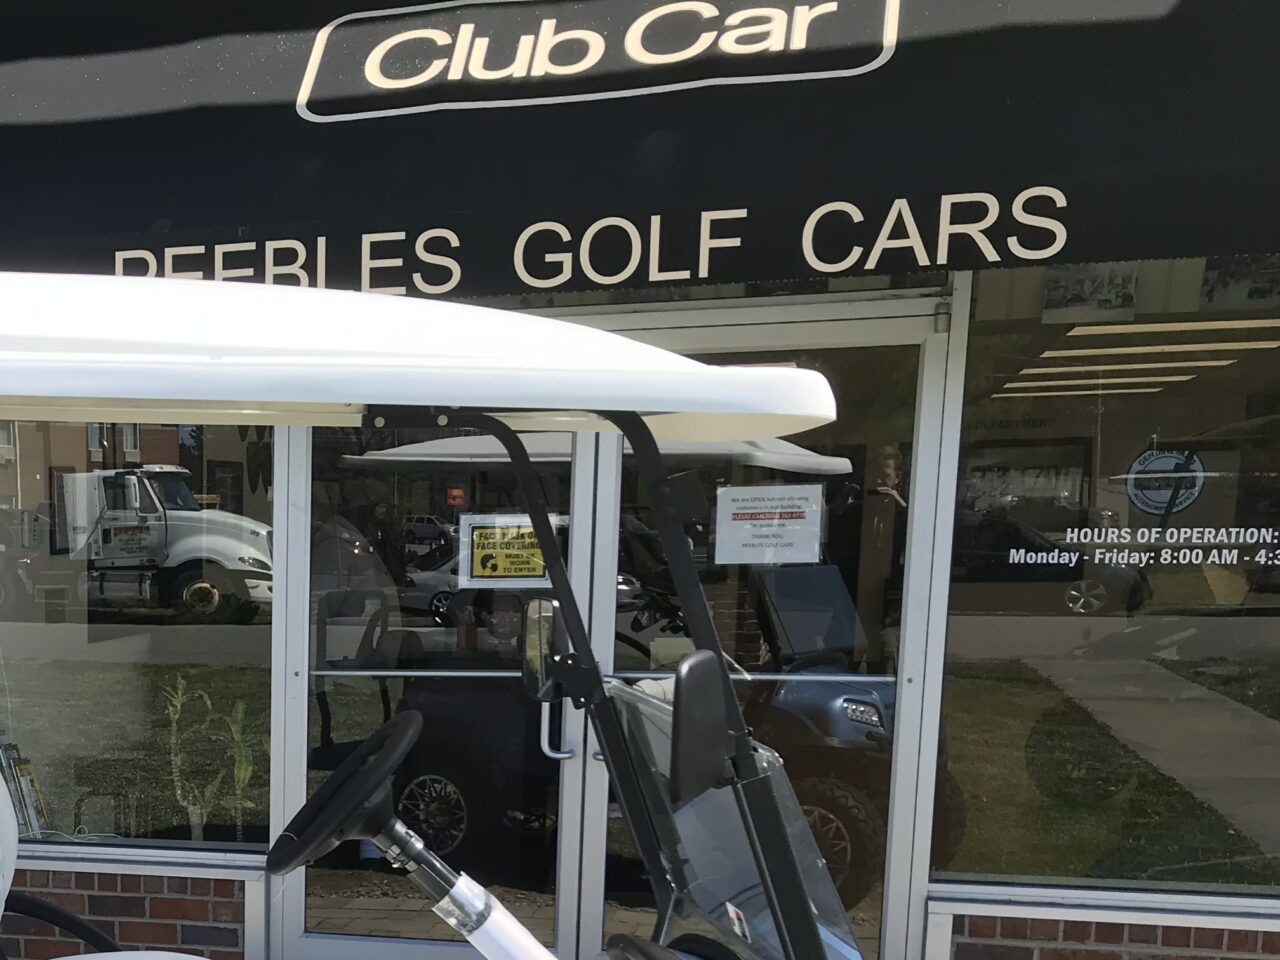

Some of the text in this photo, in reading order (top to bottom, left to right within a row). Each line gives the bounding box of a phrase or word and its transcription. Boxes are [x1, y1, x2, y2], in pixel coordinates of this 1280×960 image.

[363, 0, 838, 89] Club Car
[513, 208, 748, 289] GOLF
[801, 186, 1068, 273] CARS
[479, 532, 500, 541] FAC
[1065, 527, 1279, 543] HOURS OF OPERATION:
[476, 542, 497, 550] FACE
[1008, 548, 1080, 567] Monday
[1094, 548, 1155, 567] Friday:
[1159, 548, 1204, 565] 8:00
[1206, 549, 1239, 565] AM
